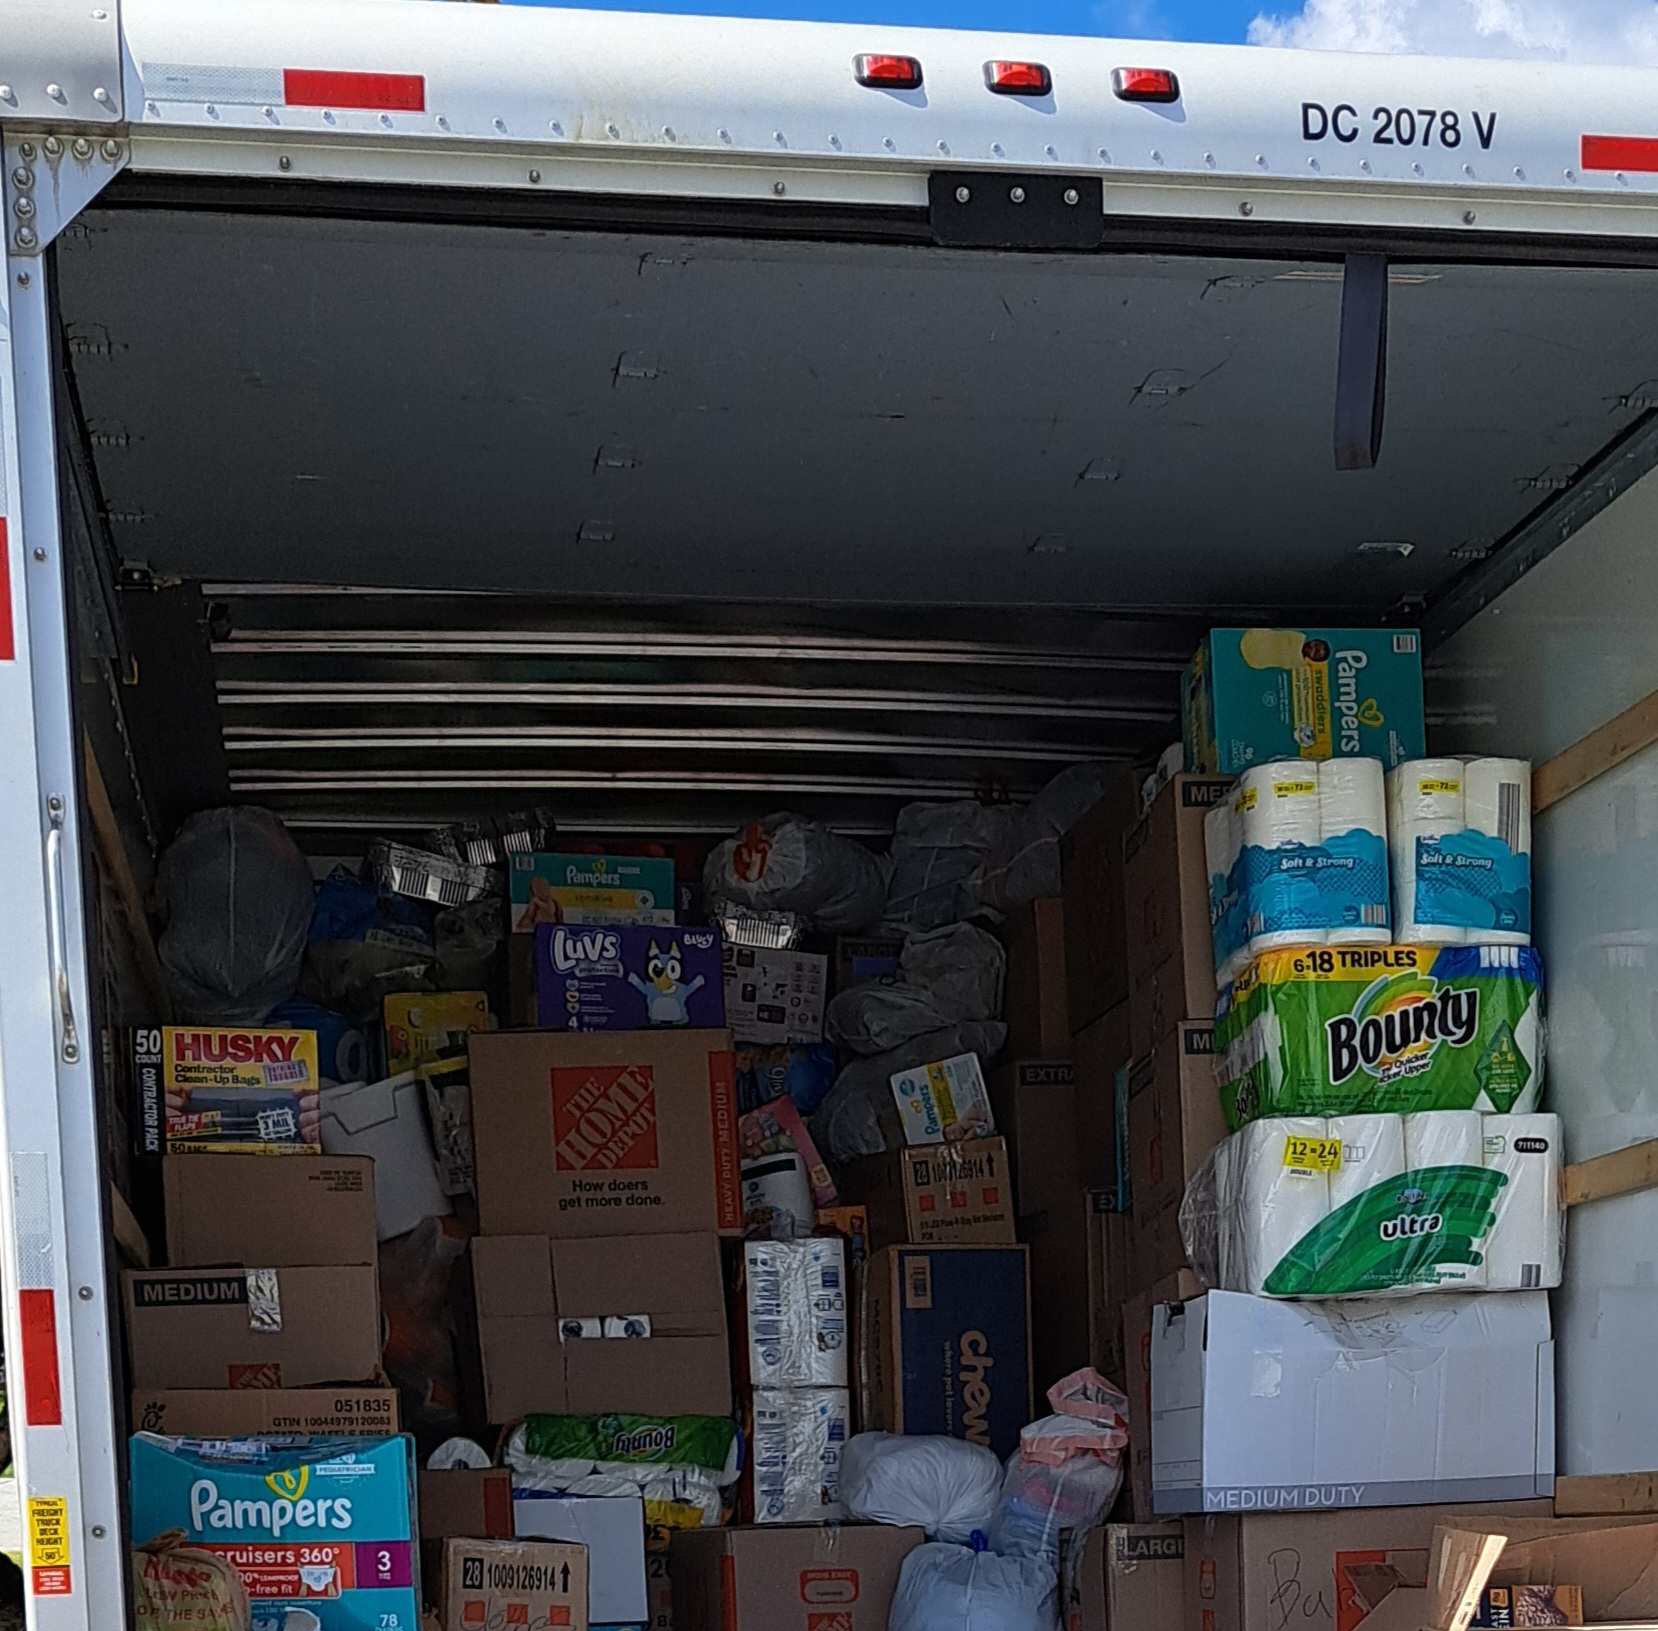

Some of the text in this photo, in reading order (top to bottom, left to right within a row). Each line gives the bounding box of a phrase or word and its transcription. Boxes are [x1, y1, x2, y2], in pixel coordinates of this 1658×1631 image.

[1301, 102, 1497, 150] DC 2078 V
[1333, 649, 1368, 752] Pampers
[1280, 855, 1354, 870] Soft & Strong
[1420, 852, 1445, 866] Soft
[1456, 855, 1493, 870] Strong
[565, 865, 621, 886] Pampers
[552, 927, 619, 973] Luvs
[1336, 951, 1417, 969] TRIPLES
[135, 1029, 161, 1054] 50
[1329, 988, 1478, 1082] Bounty
[174, 1032, 300, 1063] HUSKY
[135, 1053, 162, 1064] COUNT
[174, 1064, 237, 1074] Contractor
[1394, 1052, 1430, 1068] Quicker
[1404, 1061, 1431, 1075] Upper
[231, 1075, 261, 1086] Bags
[563, 1077, 605, 1118] THE
[142, 1067, 160, 1152] CONTRACTOR PACK
[556, 1066, 655, 1170] HOME
[716, 1080, 731, 1143] MEDIUM
[919, 1084, 940, 1135] Pampers
[595, 1102, 656, 1170] DEPOT
[170, 1144, 186, 1153] 50
[572, 1178, 649, 1192] How doers
[558, 1196, 583, 1210] get
[585, 1196, 622, 1208] more
[724, 1192, 734, 1223] HEAVY
[1381, 1215, 1441, 1239] ultra
[142, 1281, 239, 1302] MEDIUM
[941, 1340, 955, 1431] where pet lovers
[957, 1329, 996, 1447] chew
[334, 1399, 391, 1412] 051835
[273, 1417, 300, 1427] GTIN
[613, 1425, 676, 1454] Bounty
[319, 1464, 373, 1474] PEDIATRICIAN
[1206, 1485, 1366, 1509] MEDIUM DUTY
[190, 1479, 353, 1537] Pampers
[36, 1518, 61, 1527] TRUCK
[299, 1547, 340, 1564] 360°
[376, 1550, 392, 1572] 3
[464, 1559, 556, 1591] 28 1009126914
[280, 1583, 293, 1595] fit
[164, 1608, 193, 1621] THE
[379, 1613, 398, 1628] 78
